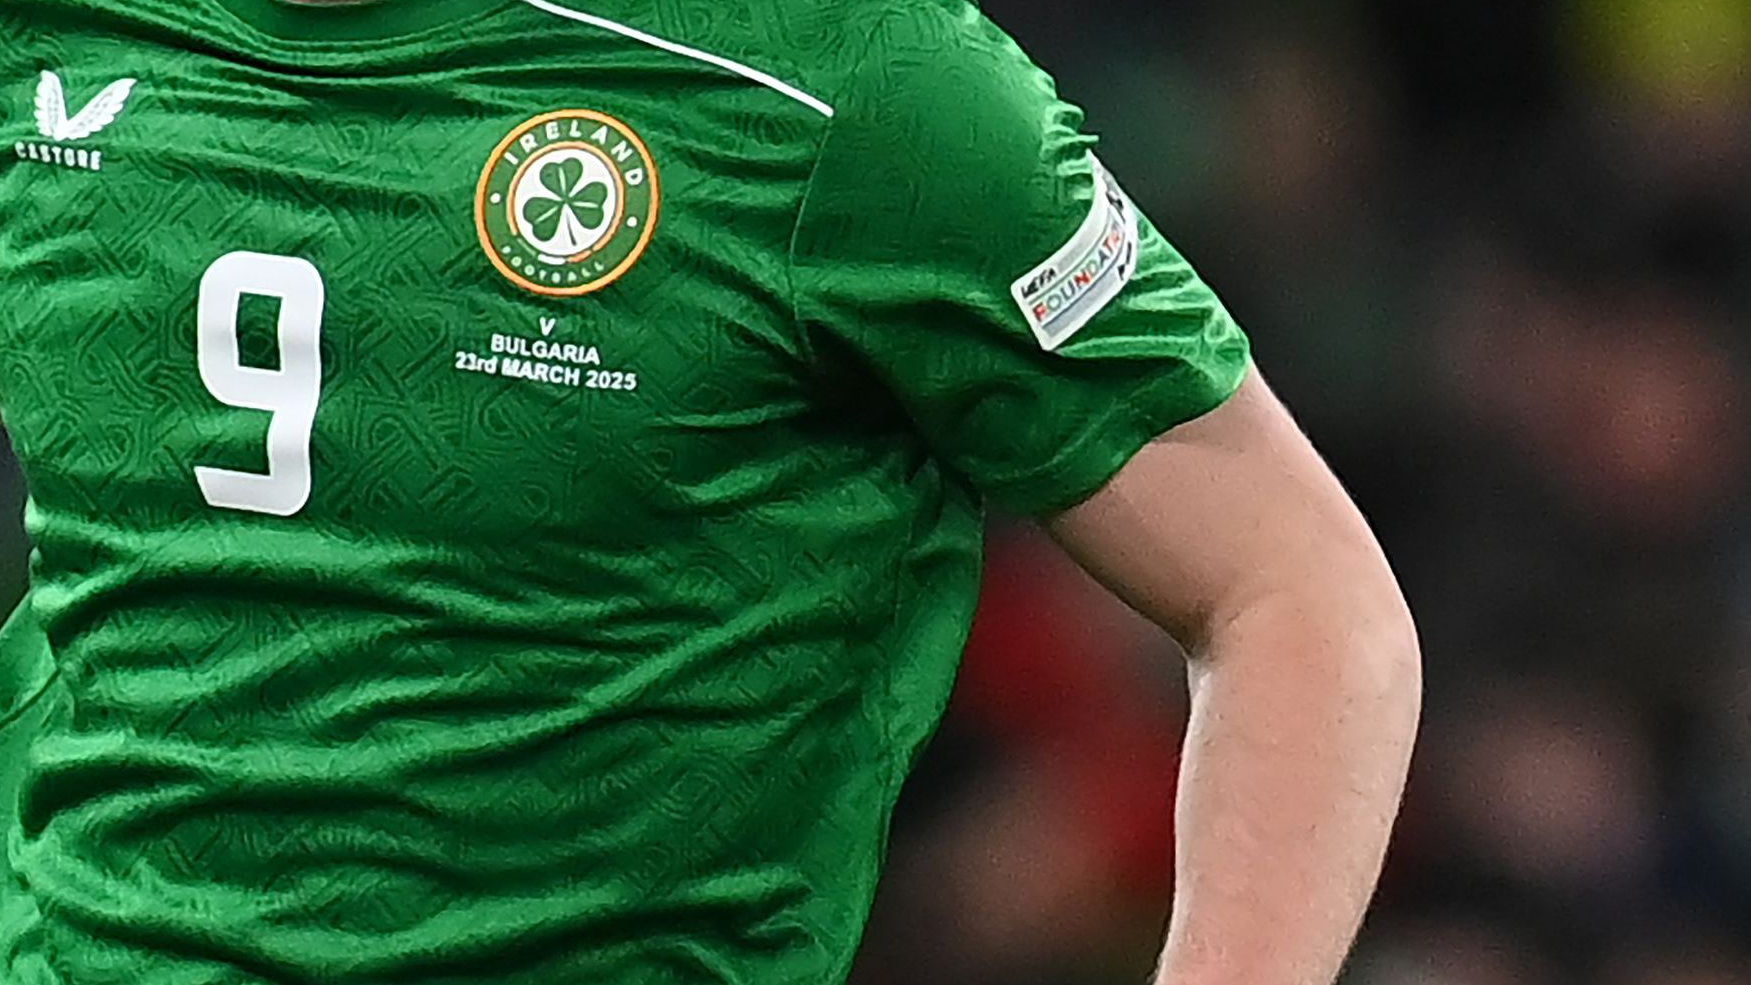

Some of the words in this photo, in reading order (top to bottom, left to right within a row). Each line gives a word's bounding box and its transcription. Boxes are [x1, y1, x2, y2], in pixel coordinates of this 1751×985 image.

[14, 141, 102, 171] CASTORE
[503, 120, 644, 186] IRELAND
[1021, 266, 1057, 299] UEFA
[490, 333, 601, 366] BULGARIA
[193, 250, 325, 516] 9
[455, 351, 499, 374] 23rd
[501, 357, 581, 387] MARCH
[585, 370, 638, 391] 2025
